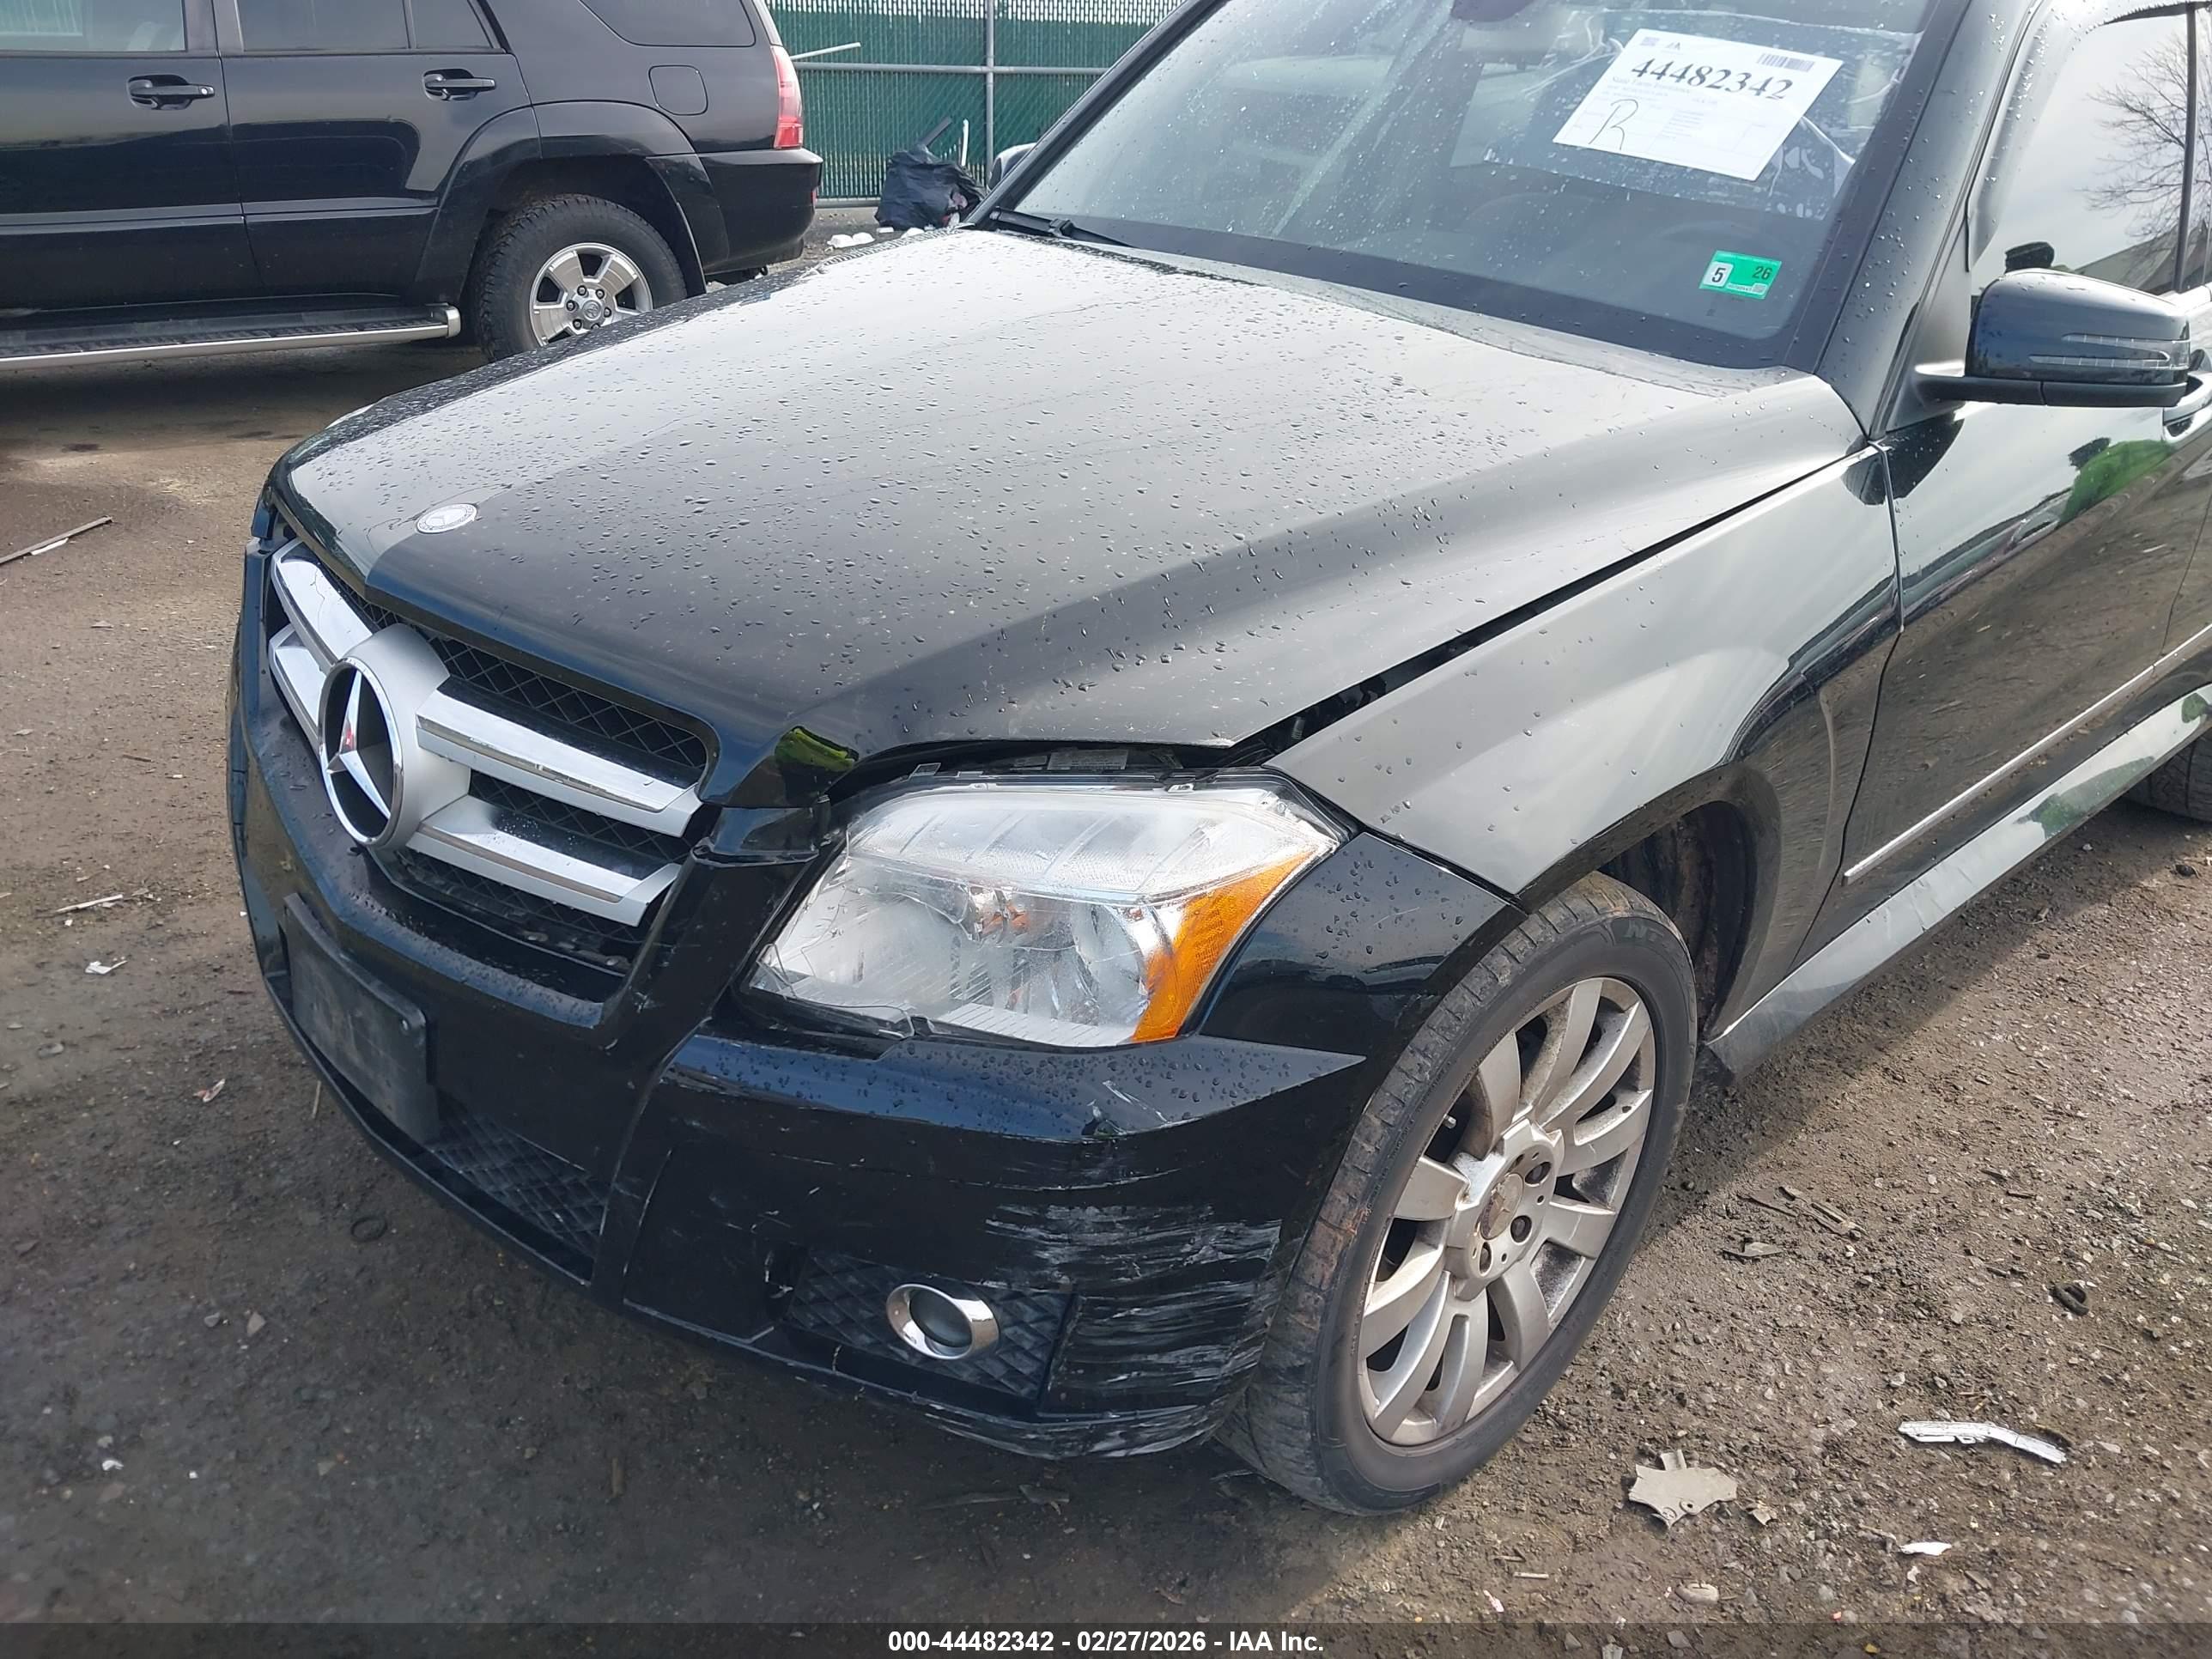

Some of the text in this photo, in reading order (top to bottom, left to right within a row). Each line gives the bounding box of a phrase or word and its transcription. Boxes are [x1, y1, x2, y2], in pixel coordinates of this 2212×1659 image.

[1632, 58, 1793, 100] 44482342
[1588, 98, 1638, 150] R
[1711, 267, 1727, 283] 5
[1753, 266, 1773, 280] 26
